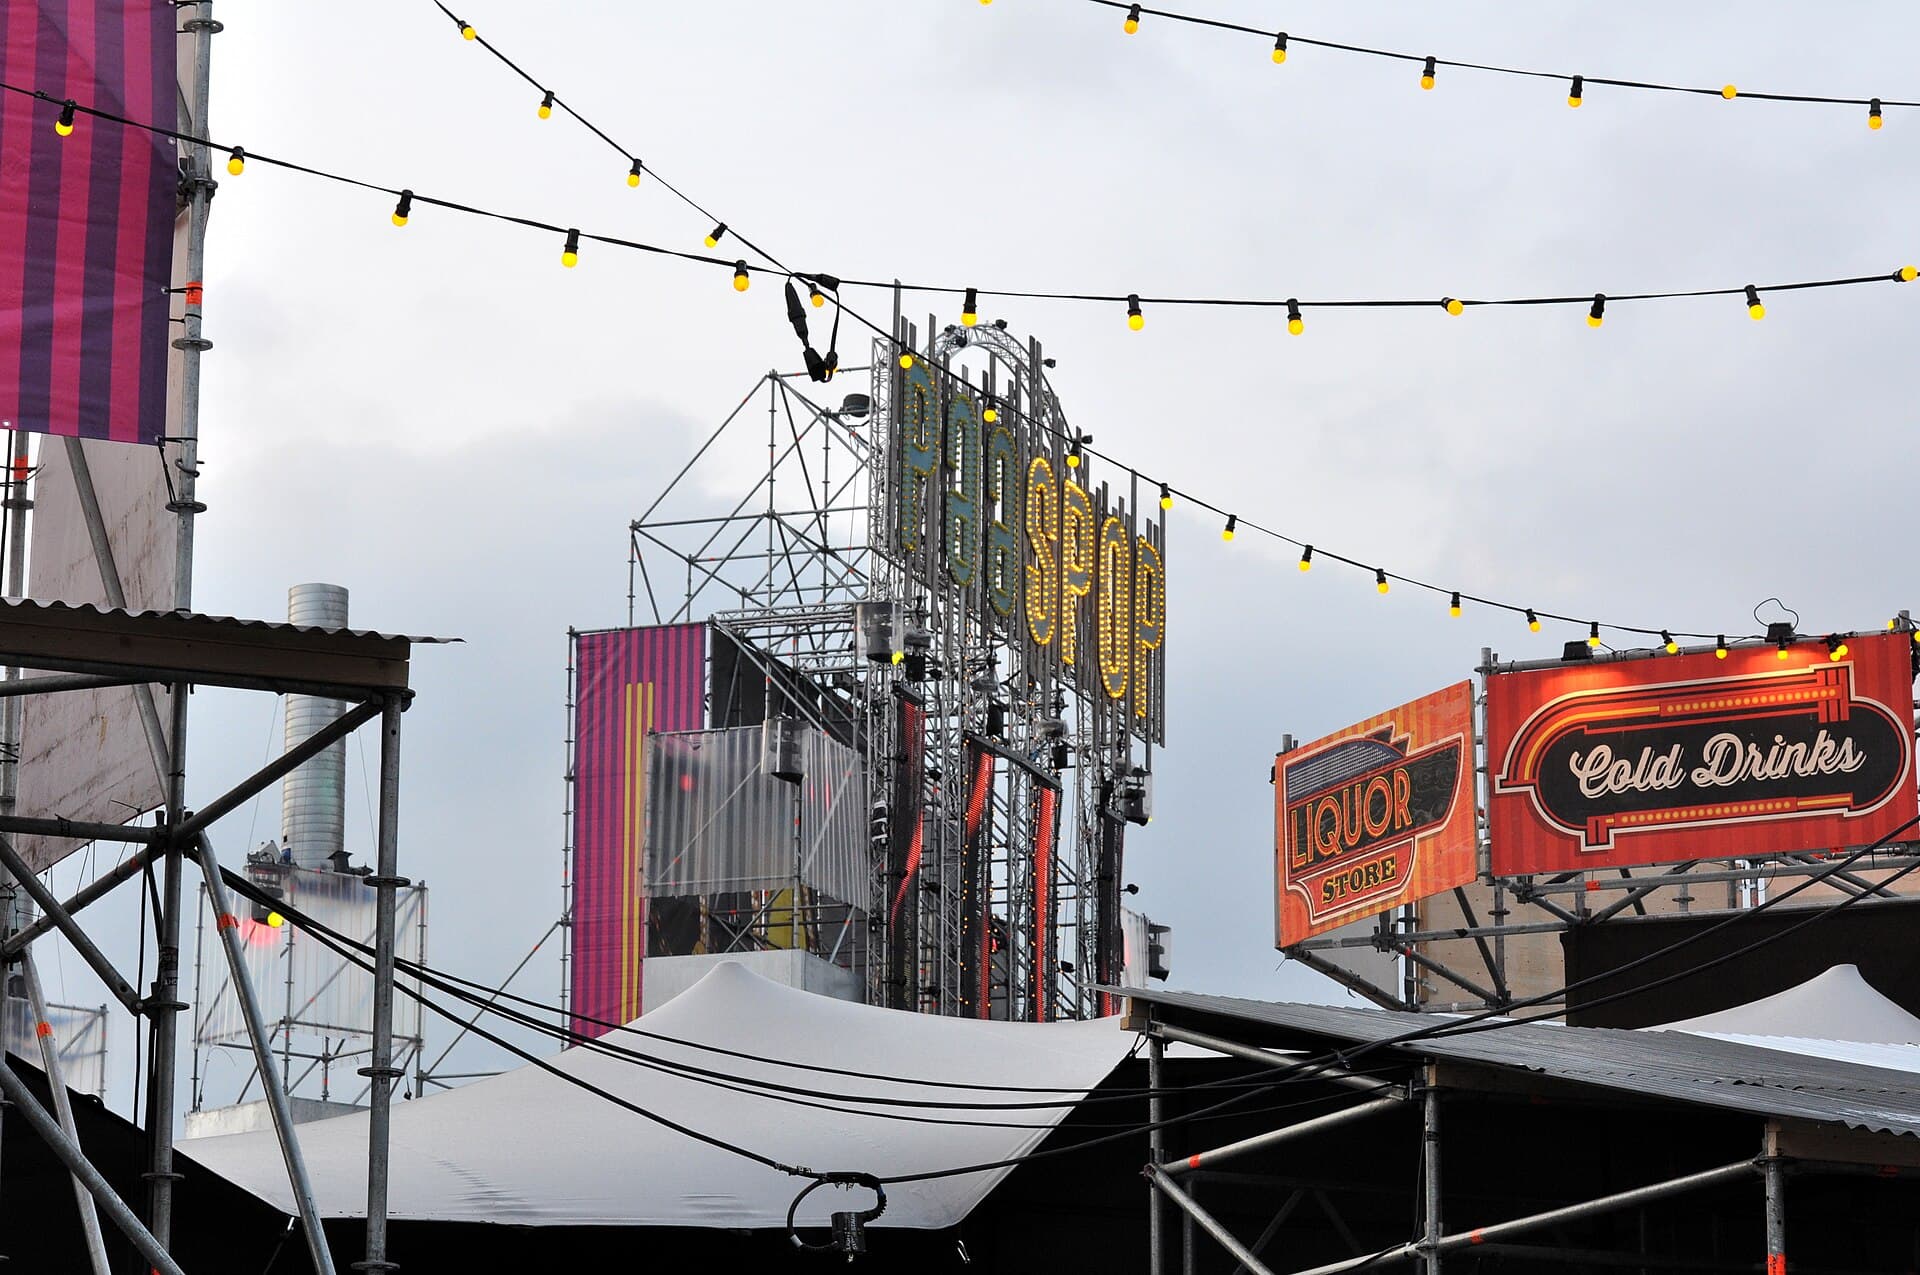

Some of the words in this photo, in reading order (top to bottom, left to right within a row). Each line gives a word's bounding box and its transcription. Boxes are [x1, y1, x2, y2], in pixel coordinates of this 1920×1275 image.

[1569, 741, 1687, 800] Cold
[1690, 729, 1868, 789] Drinks
[1290, 767, 1413, 870] LIQUOR
[1321, 852, 1397, 905] STORE
